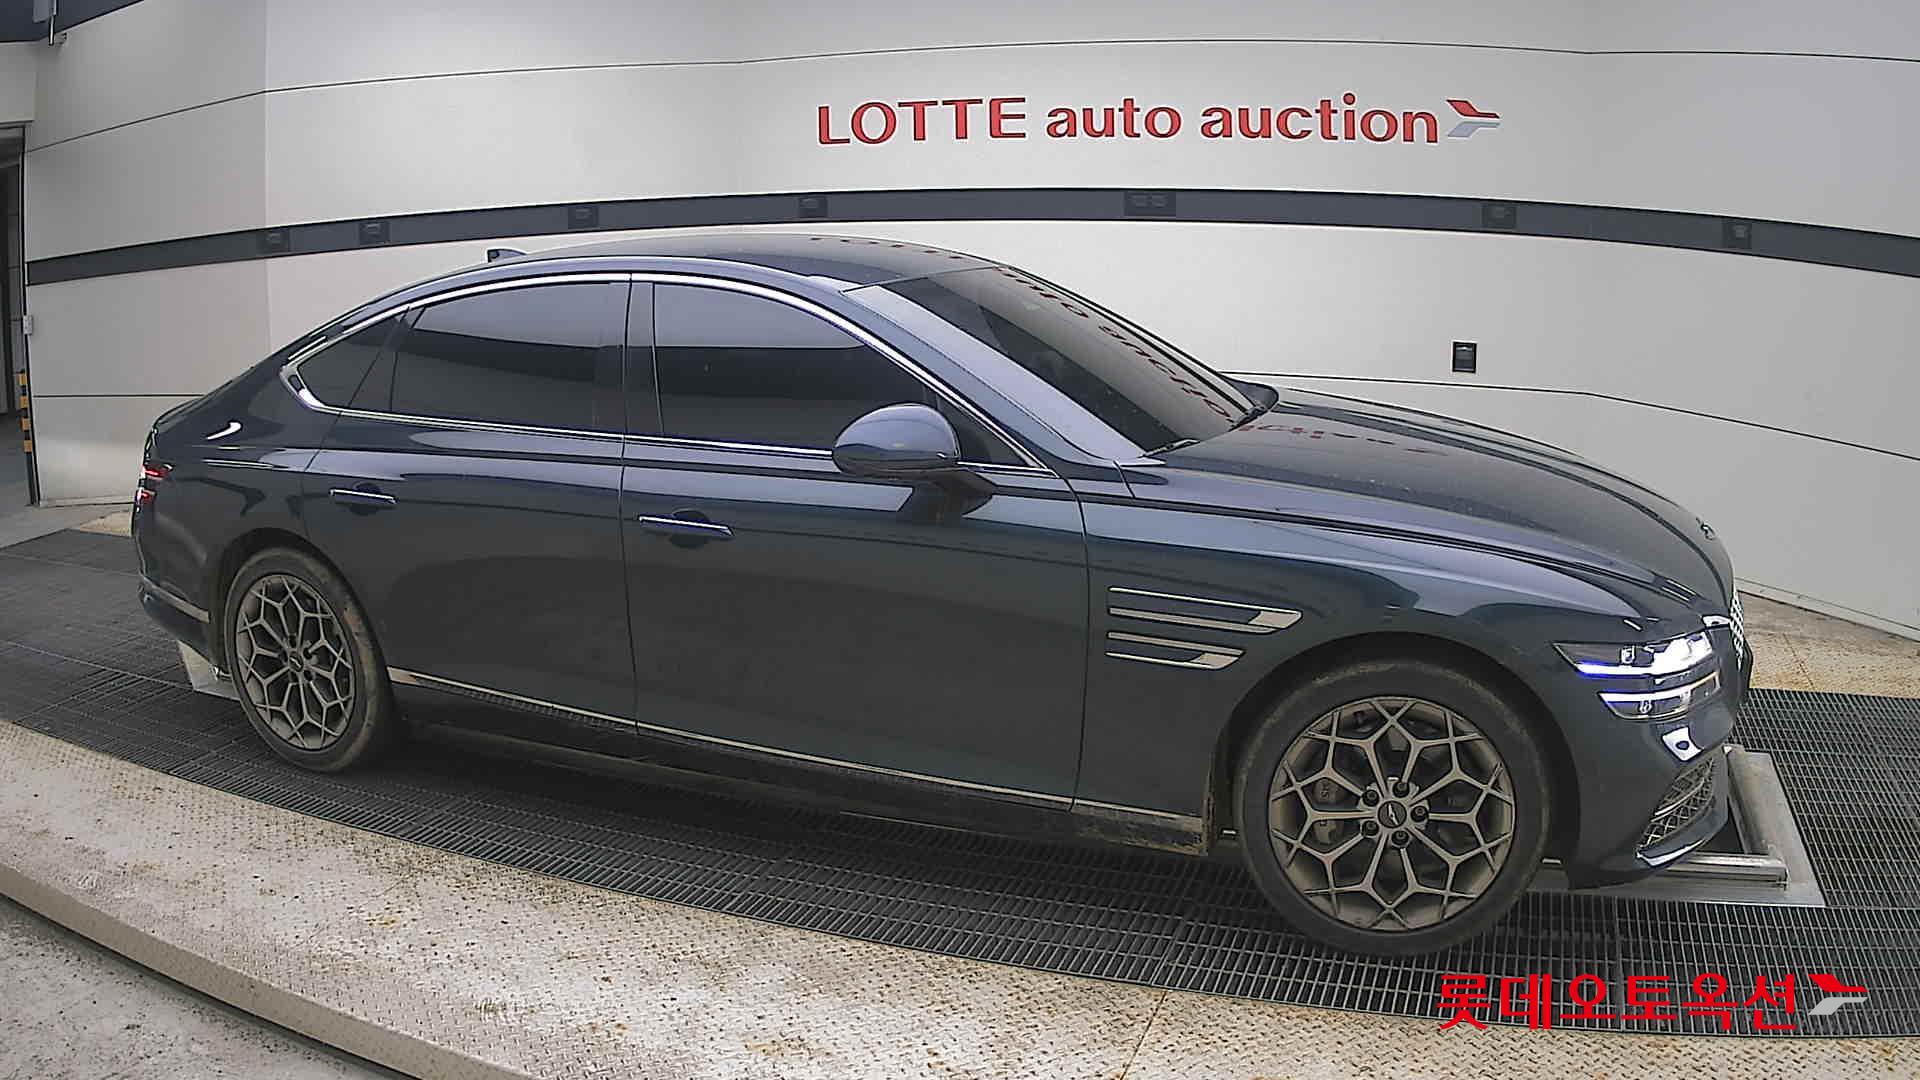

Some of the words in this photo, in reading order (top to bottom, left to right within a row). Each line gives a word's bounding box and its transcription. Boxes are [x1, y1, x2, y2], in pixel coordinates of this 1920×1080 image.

[818, 97, 1026, 145] LOTTE
[1046, 98, 1182, 138] auto
[1201, 93, 1439, 143] auction
